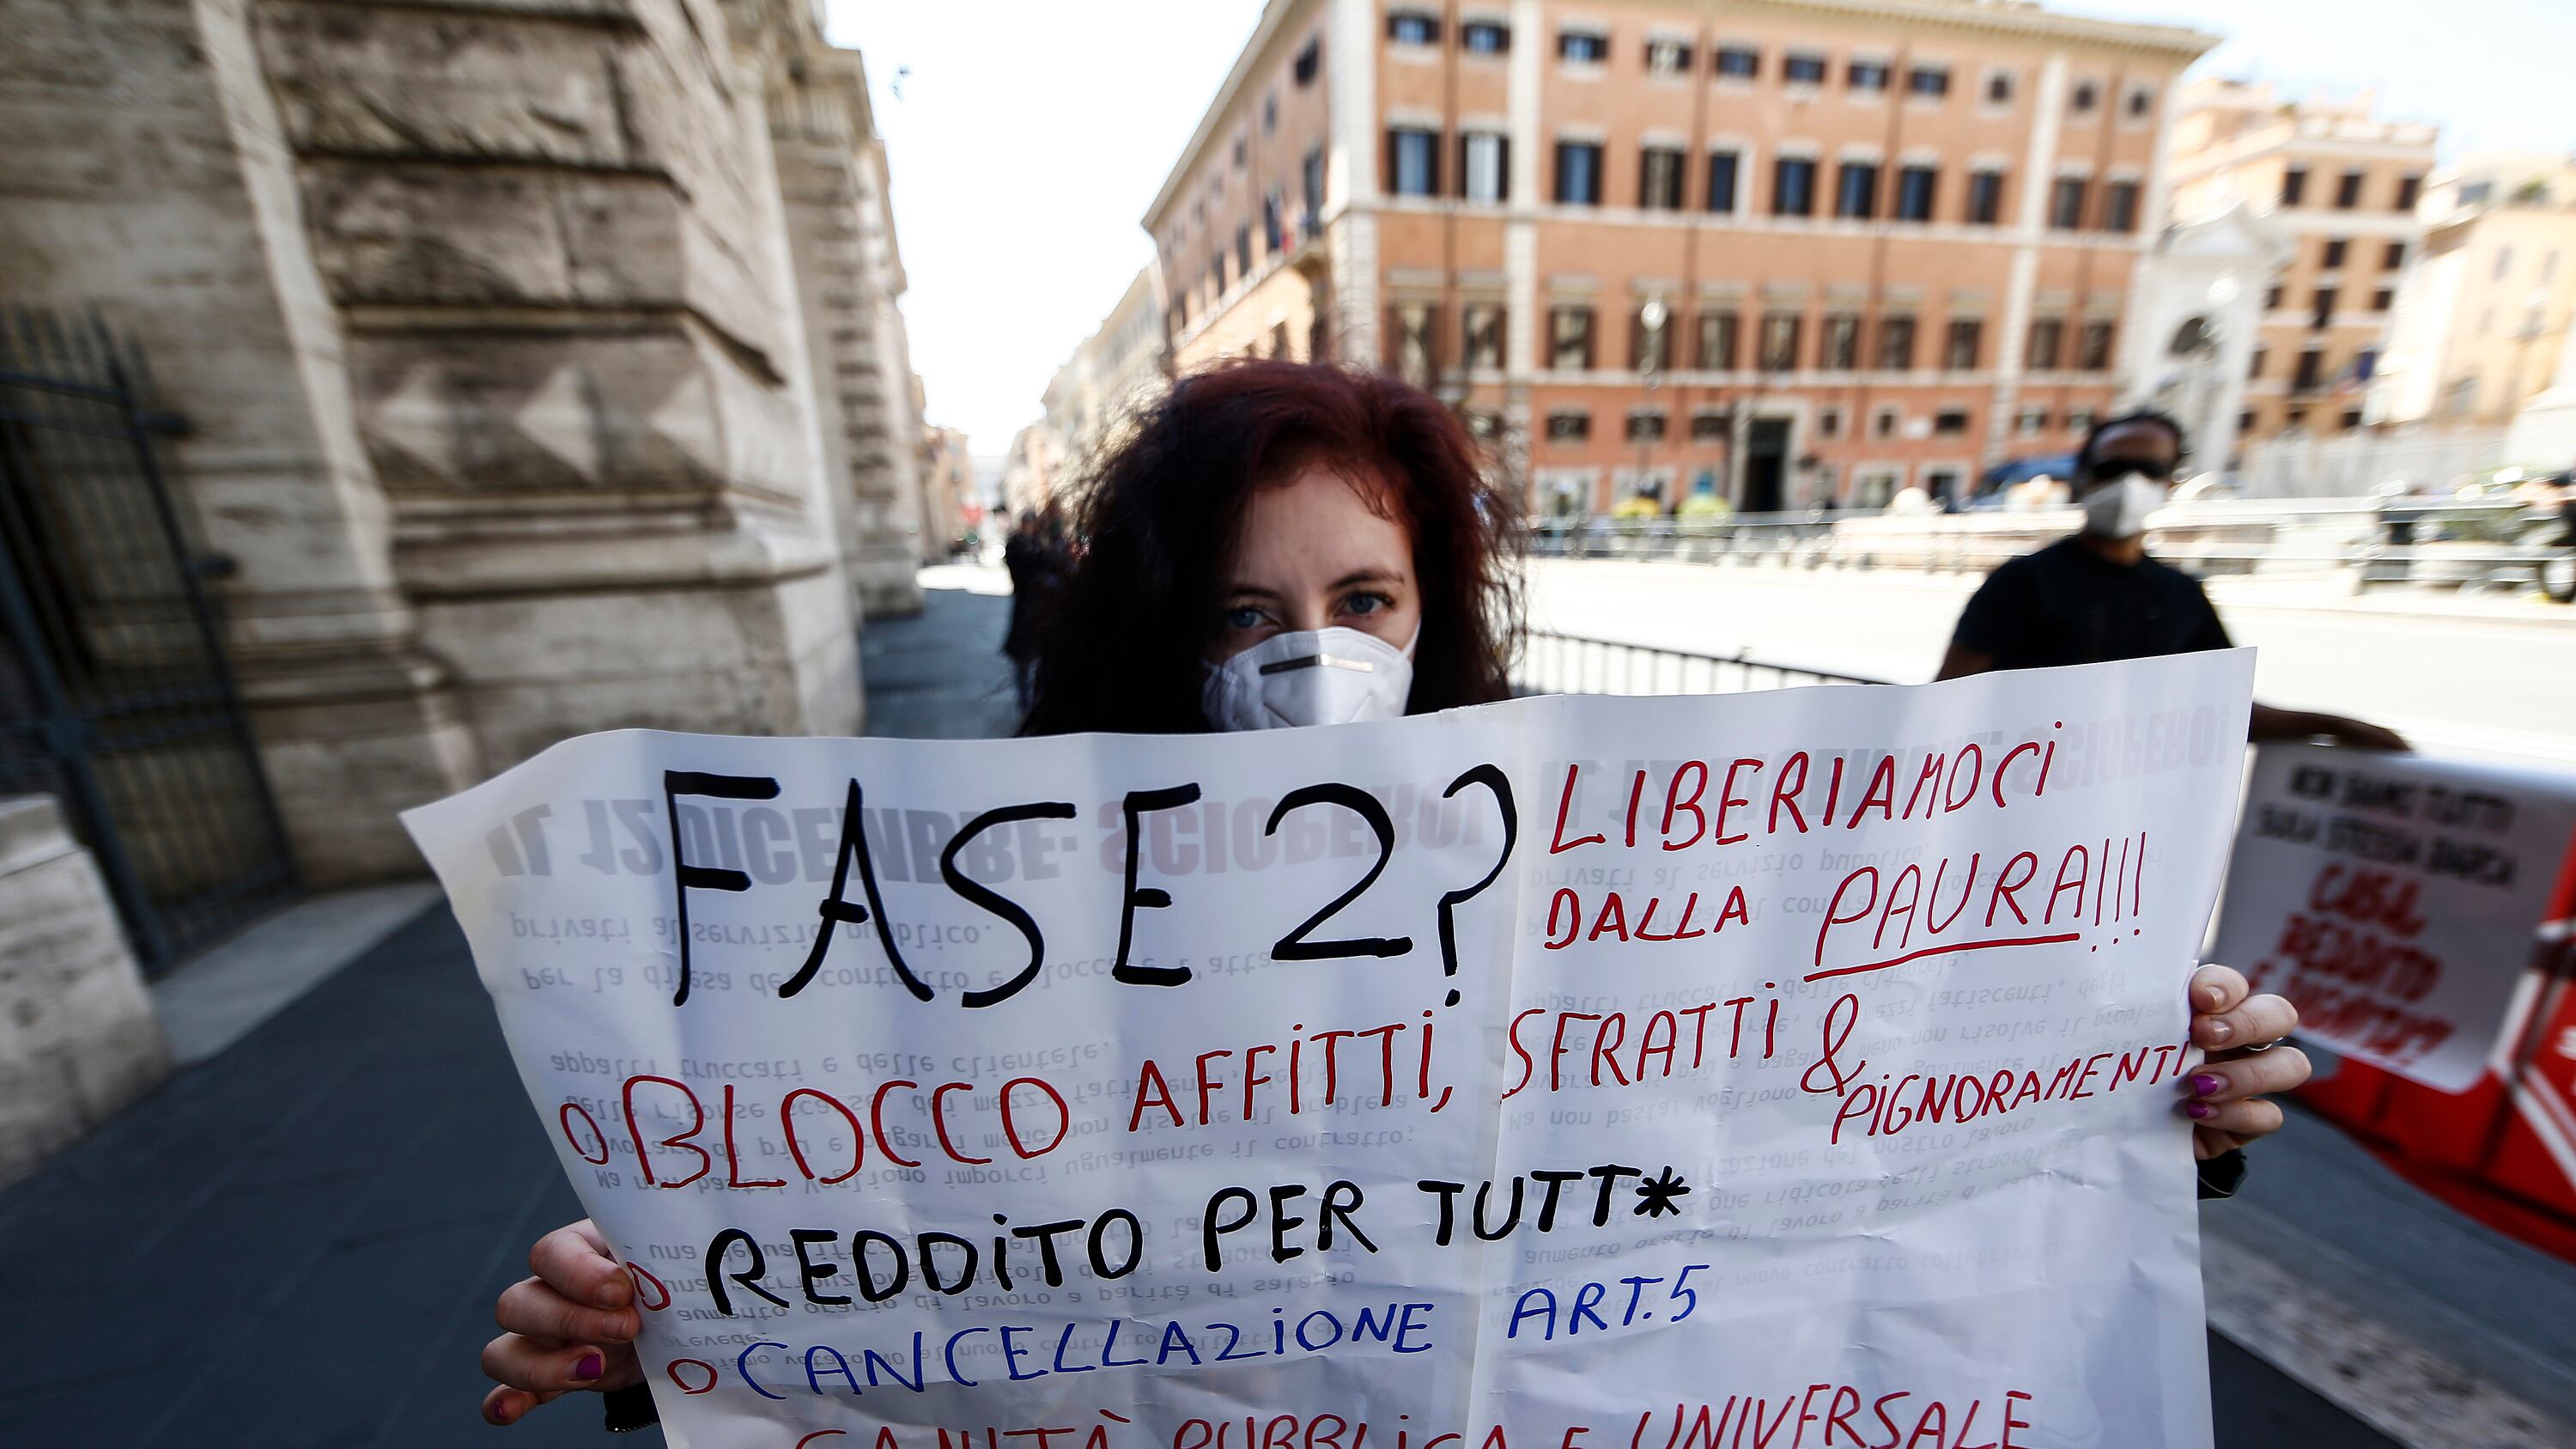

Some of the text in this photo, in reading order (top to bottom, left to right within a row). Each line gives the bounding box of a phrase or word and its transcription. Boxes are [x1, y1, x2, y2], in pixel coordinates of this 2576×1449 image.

[664, 763, 1517, 1008] FASE 2?
[1543, 884, 1750, 952] DALLA
[1813, 831, 2148, 968] PAURA!!!
[623, 1074, 1070, 1189] BLOCCO
[1800, 991, 1867, 1097] &
[704, 1208, 1144, 1316] REDDITO
[1202, 1179, 1379, 1273] PER
[736, 1303, 1435, 1401] CANCELLAZIONE
